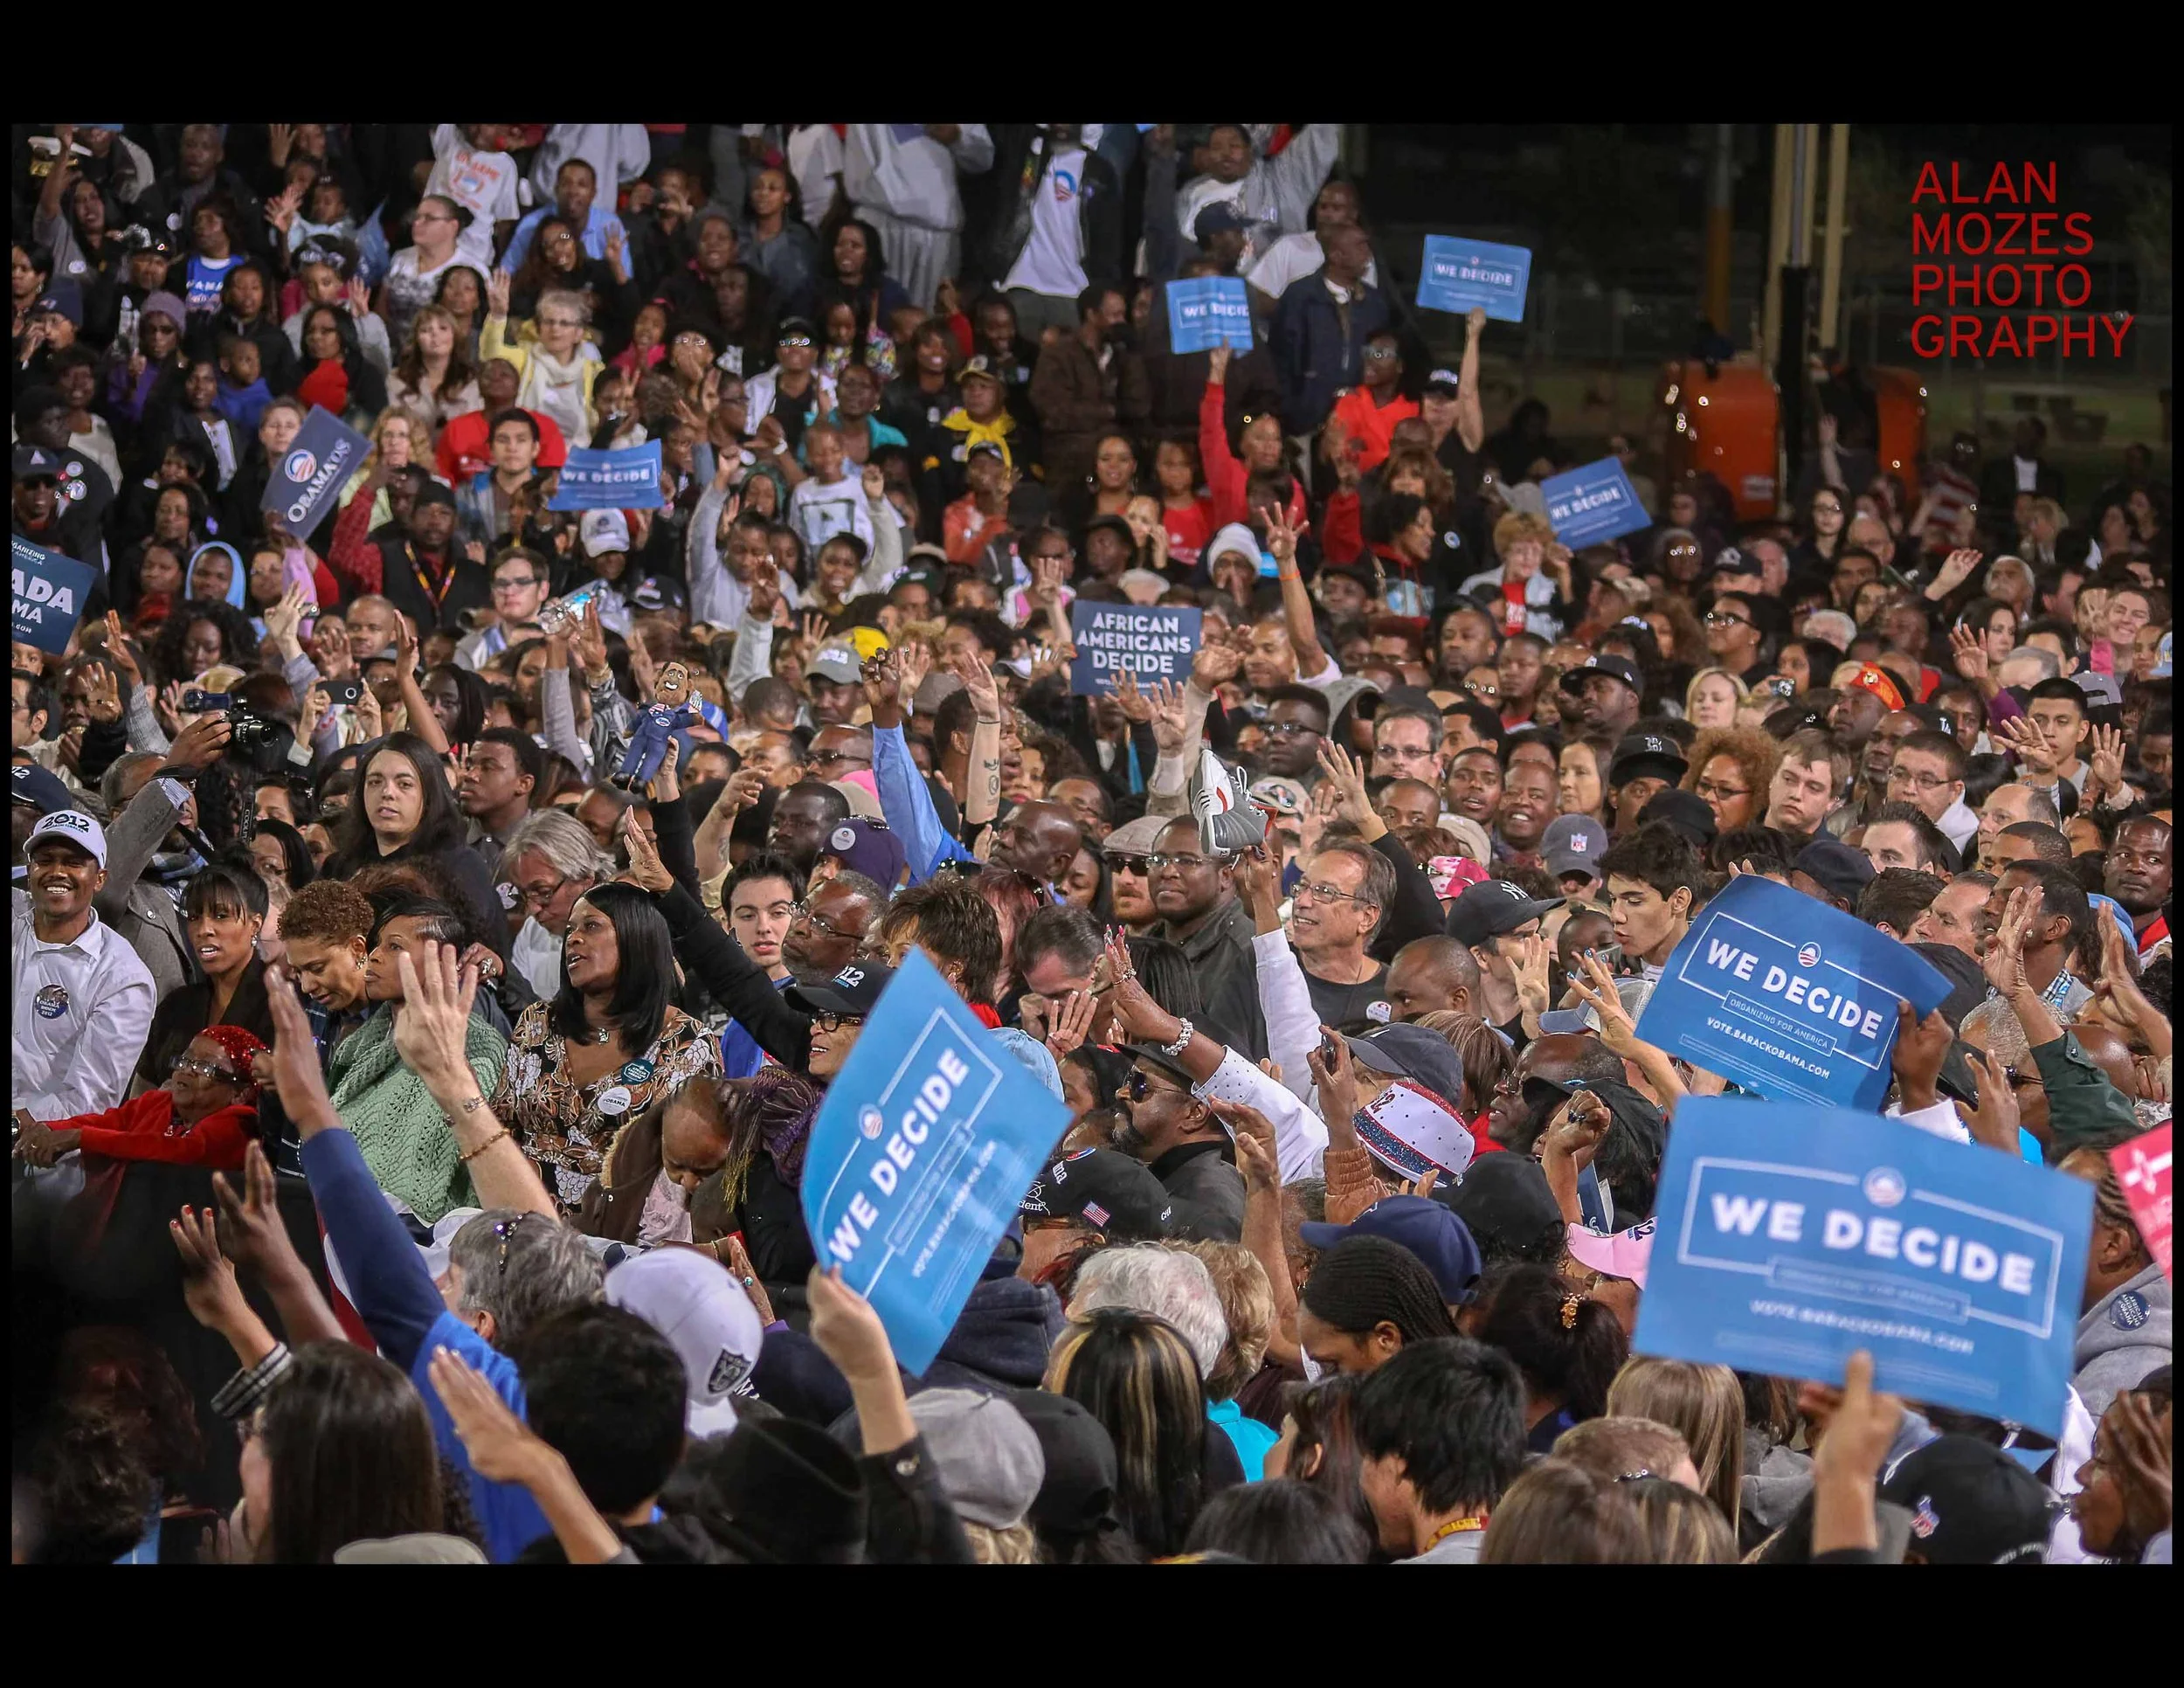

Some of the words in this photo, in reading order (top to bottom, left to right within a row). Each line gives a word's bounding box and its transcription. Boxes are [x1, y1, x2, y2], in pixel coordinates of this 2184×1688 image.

[562, 471, 588, 482] WE
[591, 468, 650, 483] DECIDE
[11, 541, 46, 561] GANIZING
[1092, 612, 1179, 633] AFRICAN
[1076, 629, 1192, 654] AMERICANS
[1091, 650, 1174, 674] DECIDE
[41, 813, 91, 834] 2012
[1706, 937, 1759, 982] WE
[1761, 965, 1883, 1040] DECIDE
[1729, 998, 1777, 1026] ORGANIZING
[1776, 1016, 1795, 1032] FOR
[1794, 1024, 1829, 1049] AMERICA
[1706, 1016, 1831, 1080] VOTE.BARACKOBAMA.COM
[827, 1191, 880, 1263] WE
[869, 1047, 971, 1197] DECIDE
[1710, 1192, 1806, 1242] WE
[1822, 1207, 2036, 1296] DECIDE
